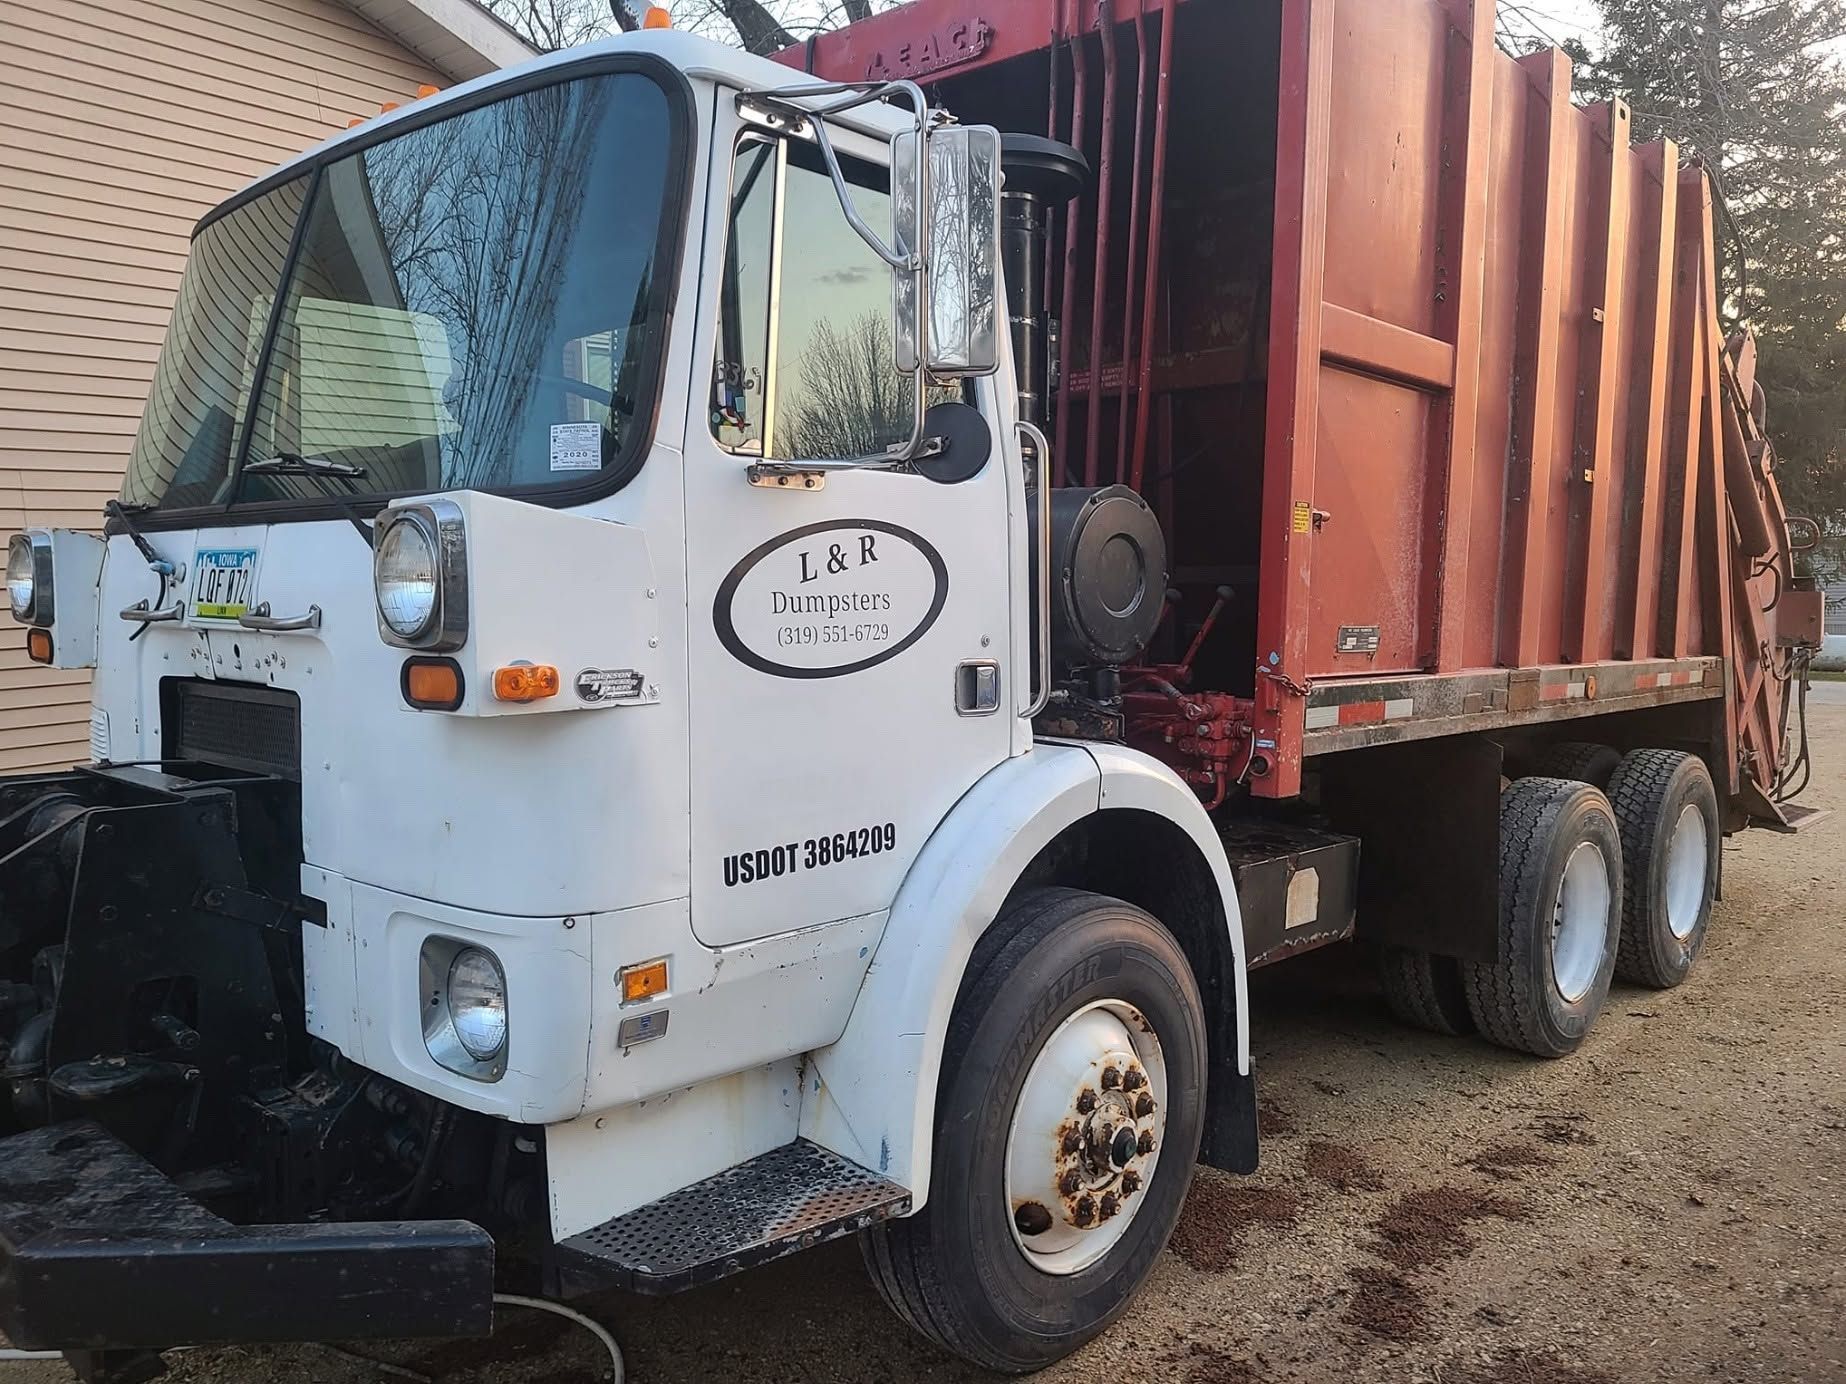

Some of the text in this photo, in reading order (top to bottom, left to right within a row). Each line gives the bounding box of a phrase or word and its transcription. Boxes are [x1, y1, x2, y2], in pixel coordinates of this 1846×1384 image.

[219, 553, 238, 566] IOWA
[798, 534, 879, 584] L & R
[771, 590, 891, 618] Dumpsters
[777, 623, 889, 647] (319) 551-6729
[579, 672, 633, 685] ERICKSON
[723, 822, 896, 887] USDOT 3864209
